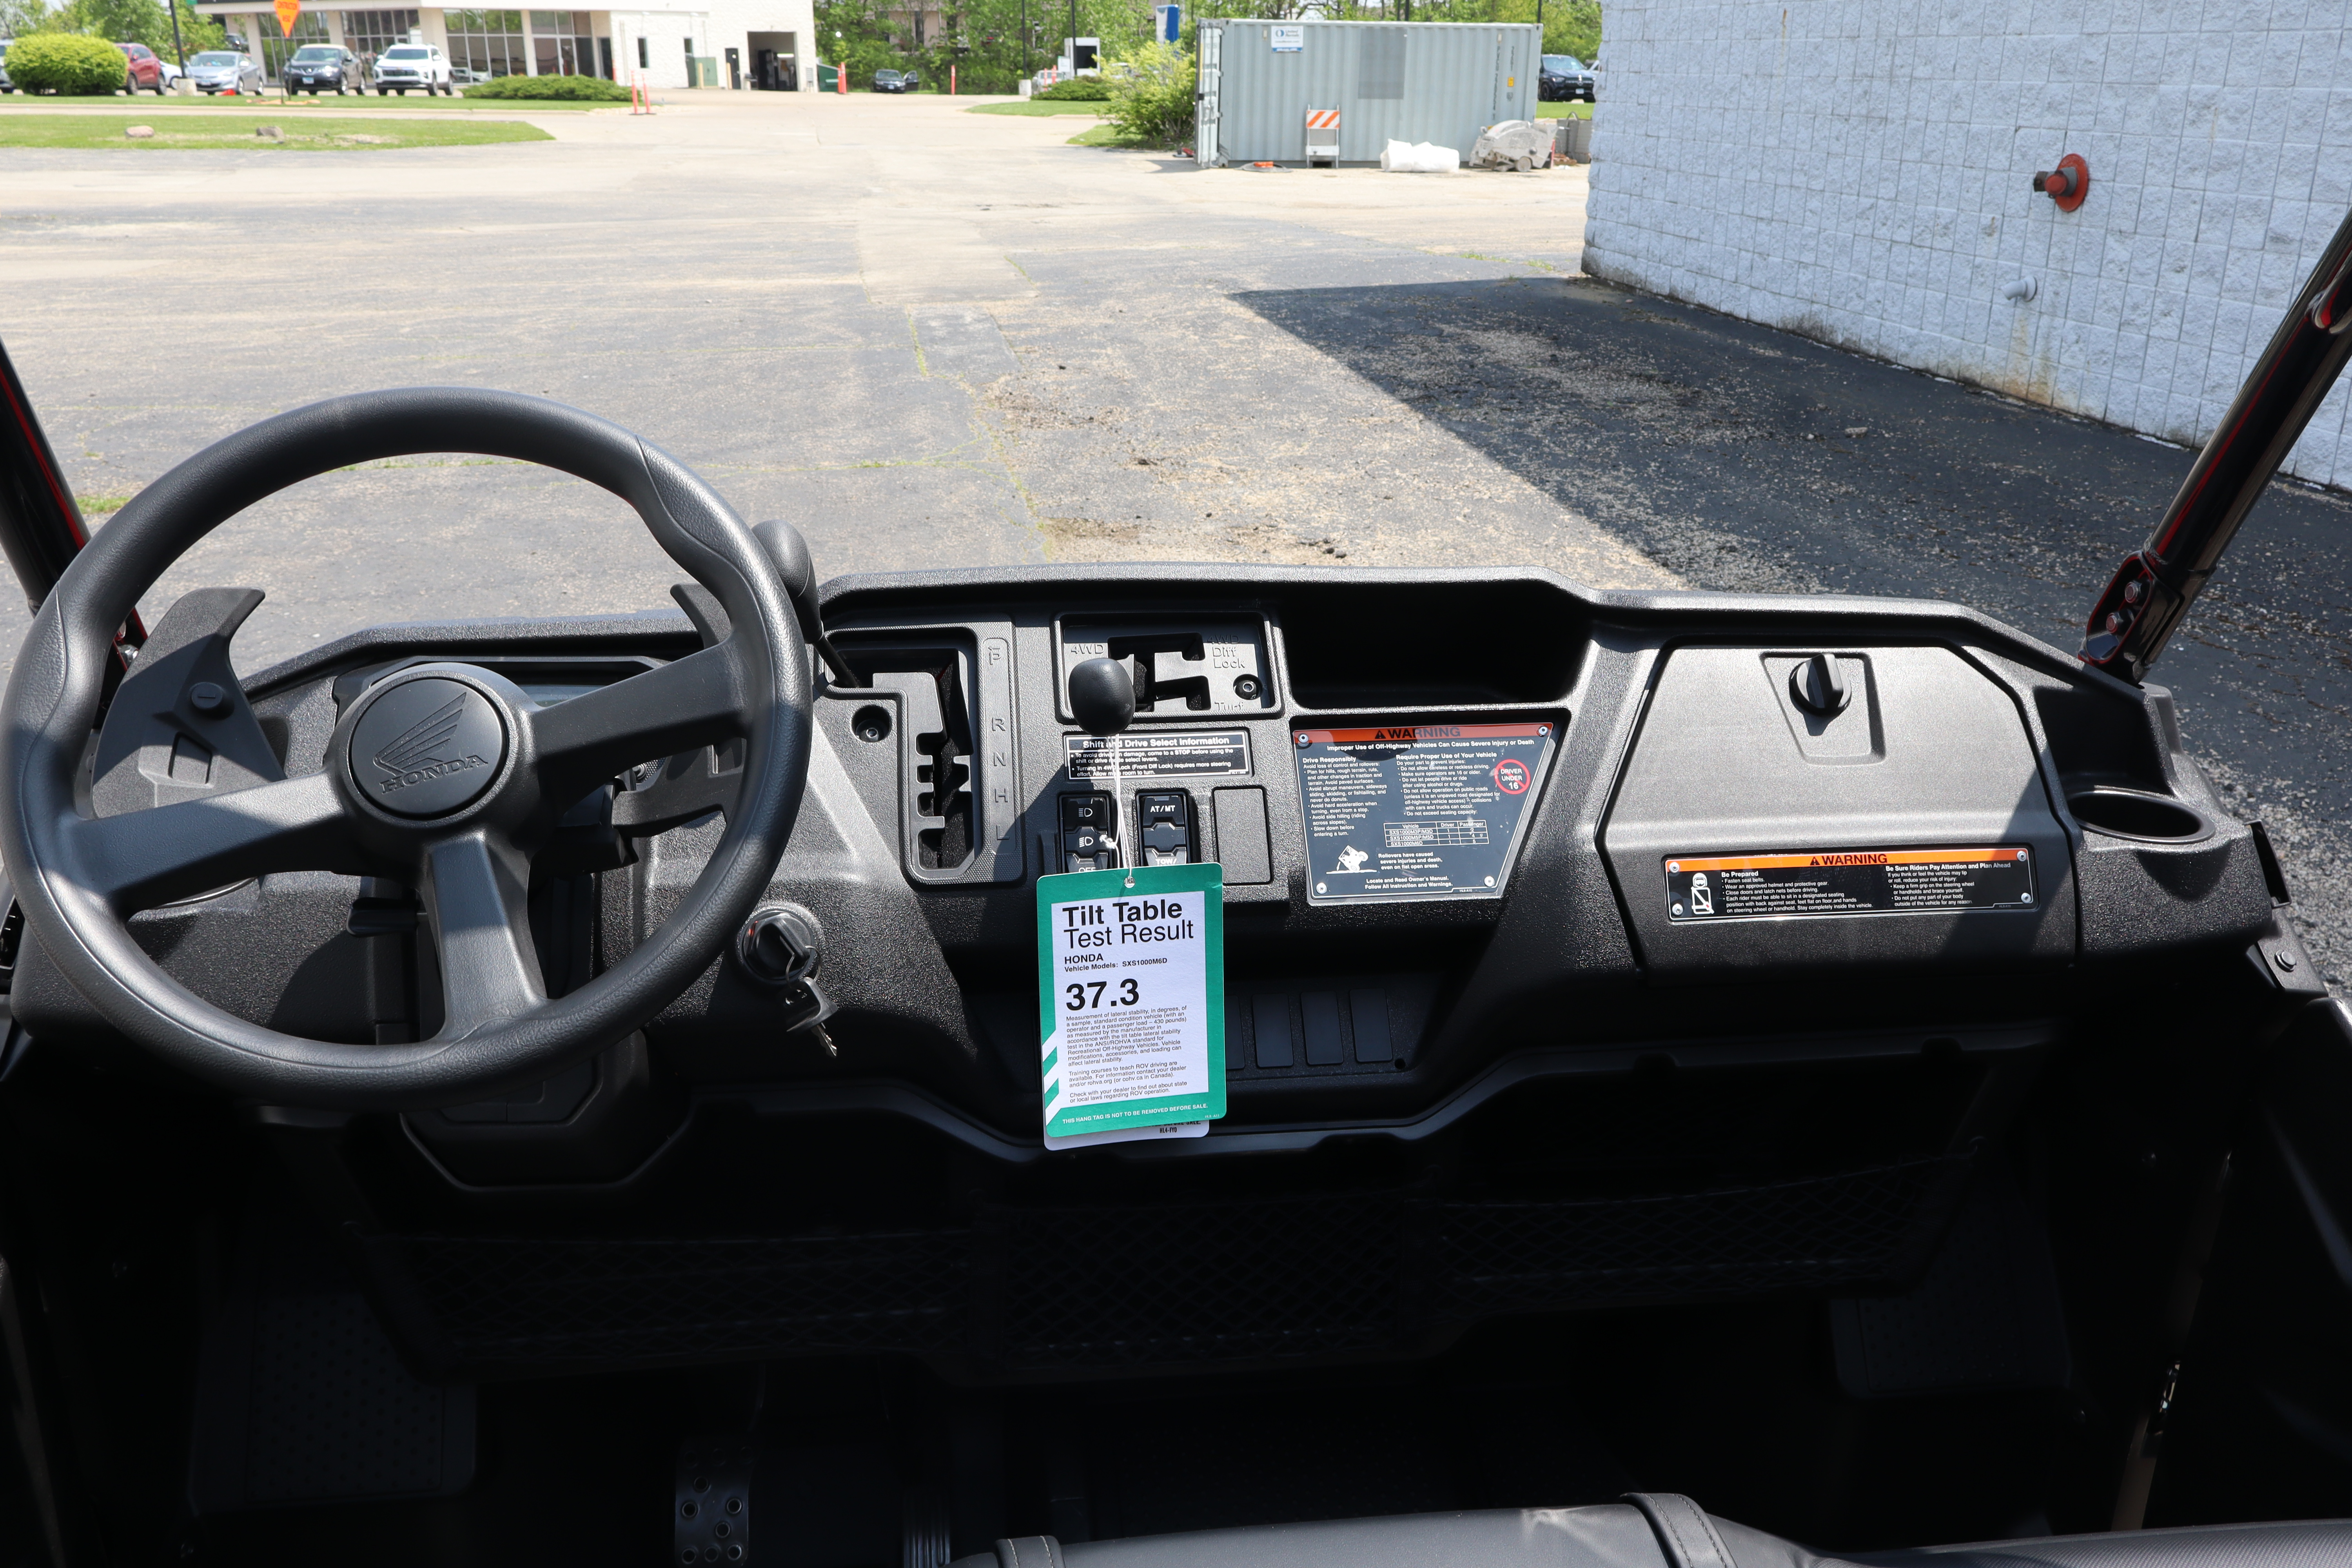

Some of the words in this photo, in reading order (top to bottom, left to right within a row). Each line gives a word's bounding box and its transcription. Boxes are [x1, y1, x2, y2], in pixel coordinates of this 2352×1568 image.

[1207, 635, 1240, 644] 4WD
[1071, 643, 1104, 654] 4WD
[1212, 646, 1236, 657] Diff
[1213, 658, 1245, 668] Lock
[1214, 701, 1244, 710] Turf
[991, 717, 1006, 731] R
[1387, 727, 1460, 739] WARNING
[1179, 737, 1230, 746] Information
[993, 752, 1007, 766] N
[379, 755, 488, 794] HONDA
[995, 788, 1008, 803] H
[996, 825, 1010, 840] L
[1822, 854, 1887, 865] WARNING
[1062, 905, 1104, 927] Tilt
[1112, 900, 1182, 922] Table
[1063, 927, 1112, 949] Test
[1122, 919, 1194, 944] Result
[1065, 953, 1103, 964] HONDA
[1122, 958, 1167, 967] SXS1000M6D
[1066, 978, 1139, 1011] 37.3
